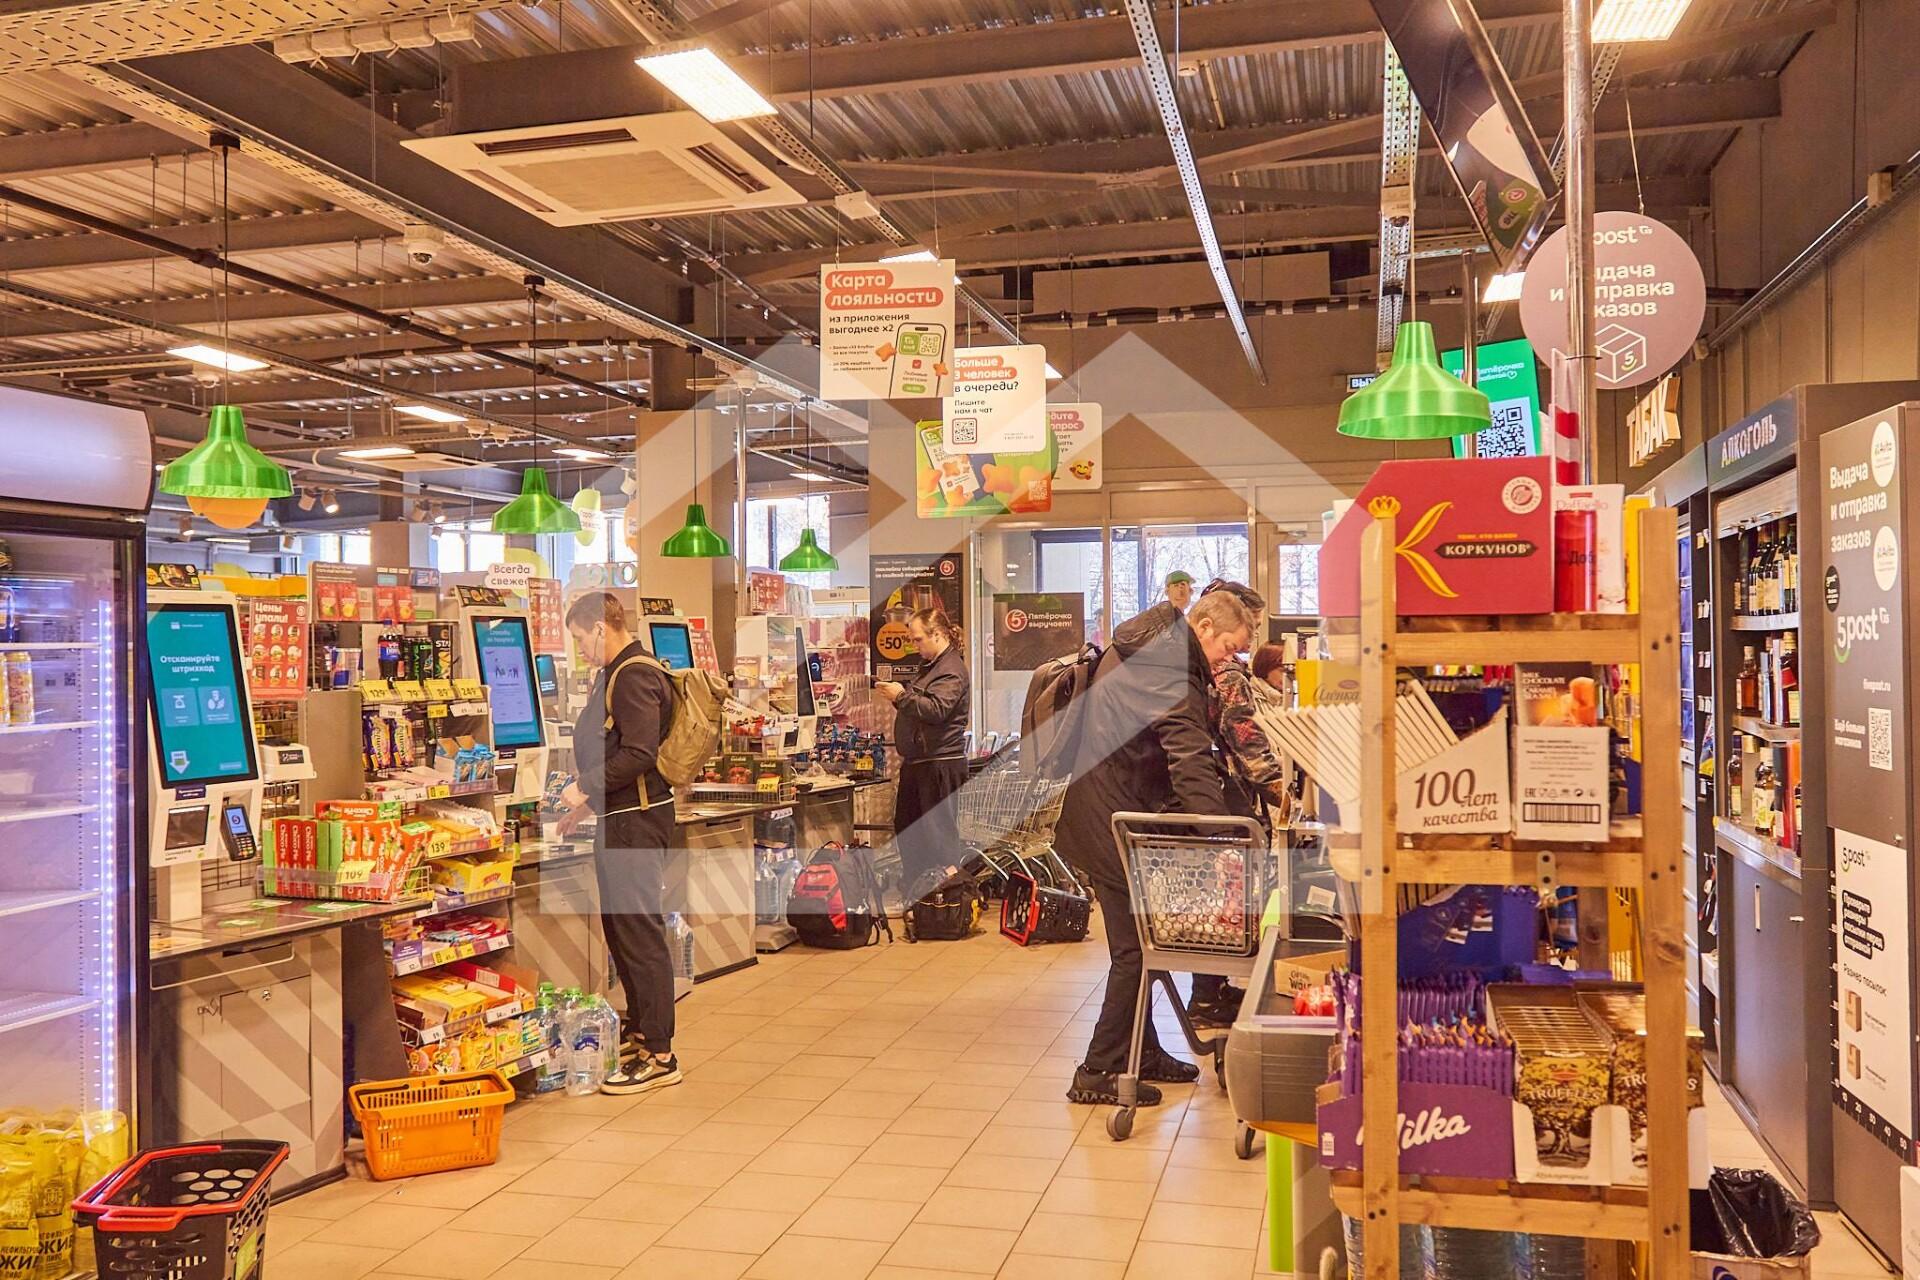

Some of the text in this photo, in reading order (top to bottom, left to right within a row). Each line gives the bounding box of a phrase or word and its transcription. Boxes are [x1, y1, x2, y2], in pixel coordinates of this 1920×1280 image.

[831, 274, 886, 289] Карта
[831, 291, 937, 306] лояльности
[1549, 287, 1565, 301] и
[843, 313, 910, 324] приложения
[829, 326, 880, 335] выгоднее
[954, 357, 998, 367] Больше
[963, 368, 1012, 379] человек
[964, 381, 1019, 393] очереди?
[1626, 372, 1680, 467] ТАБАК
[1721, 414, 1777, 468] АЛКОГОЛЬ
[1829, 462, 1869, 489] Выдача
[1830, 491, 1887, 522] и отправка
[1830, 529, 1872, 553] заказов
[1444, 543, 1527, 556] КОРКУНОВ
[493, 564, 530, 574] Всегда
[255, 602, 282, 613] Цены
[255, 613, 288, 623] упали!
[1028, 611, 1072, 621] Пятёрочка
[1028, 620, 1072, 629] выручает!
[1837, 608, 1880, 649] 5post
[160, 653, 220, 663] Отсканируйте
[171, 665, 215, 674] штрихкод
[1414, 768, 1476, 809] 100
[1460, 791, 1499, 808] лет
[1422, 808, 1499, 828] качества
[431, 843, 446, 853] 139
[1842, 847, 1865, 867] 5post
[1528, 1087, 1600, 1101] TRUFFLES
